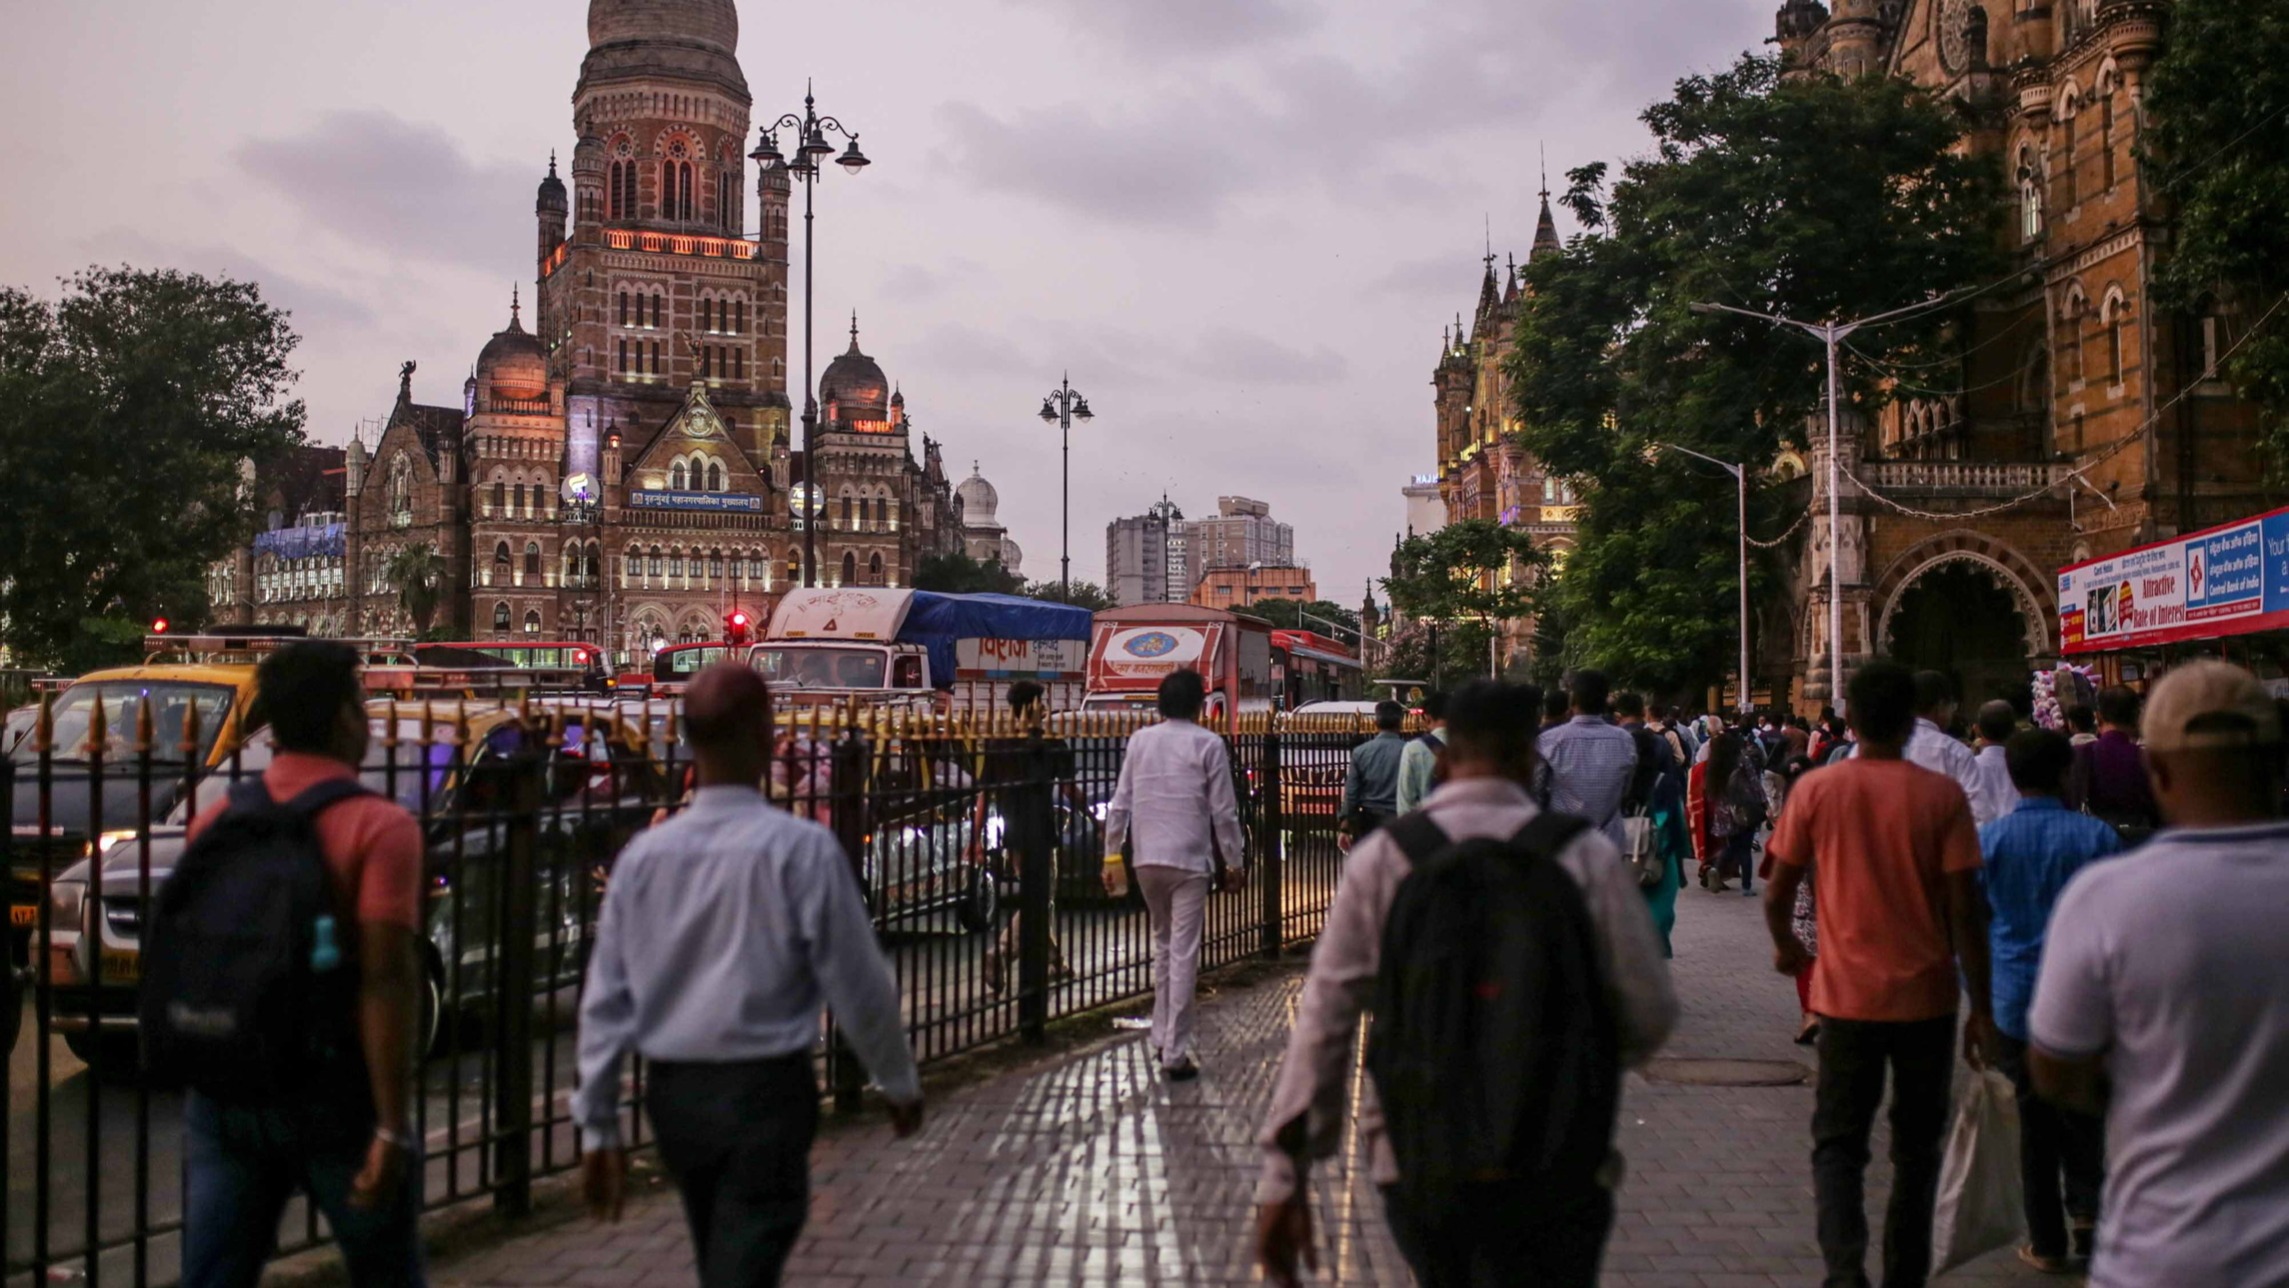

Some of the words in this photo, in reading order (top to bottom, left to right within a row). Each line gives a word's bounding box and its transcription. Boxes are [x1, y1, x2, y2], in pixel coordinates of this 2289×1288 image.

[672, 494, 720, 506] महानगरपालिका
[721, 497, 749, 508] मुख्यालय
[2267, 538, 2285, 556] Your
[2143, 576, 2176, 598] Attractive
[2209, 579, 2226, 596] Central
[2226, 578, 2239, 593] Bank
[2239, 576, 2246, 591] of
[2246, 574, 2259, 589] India
[2133, 609, 2148, 628] Rate
[2149, 605, 2157, 626] of
[2157, 601, 2186, 625] Interest
